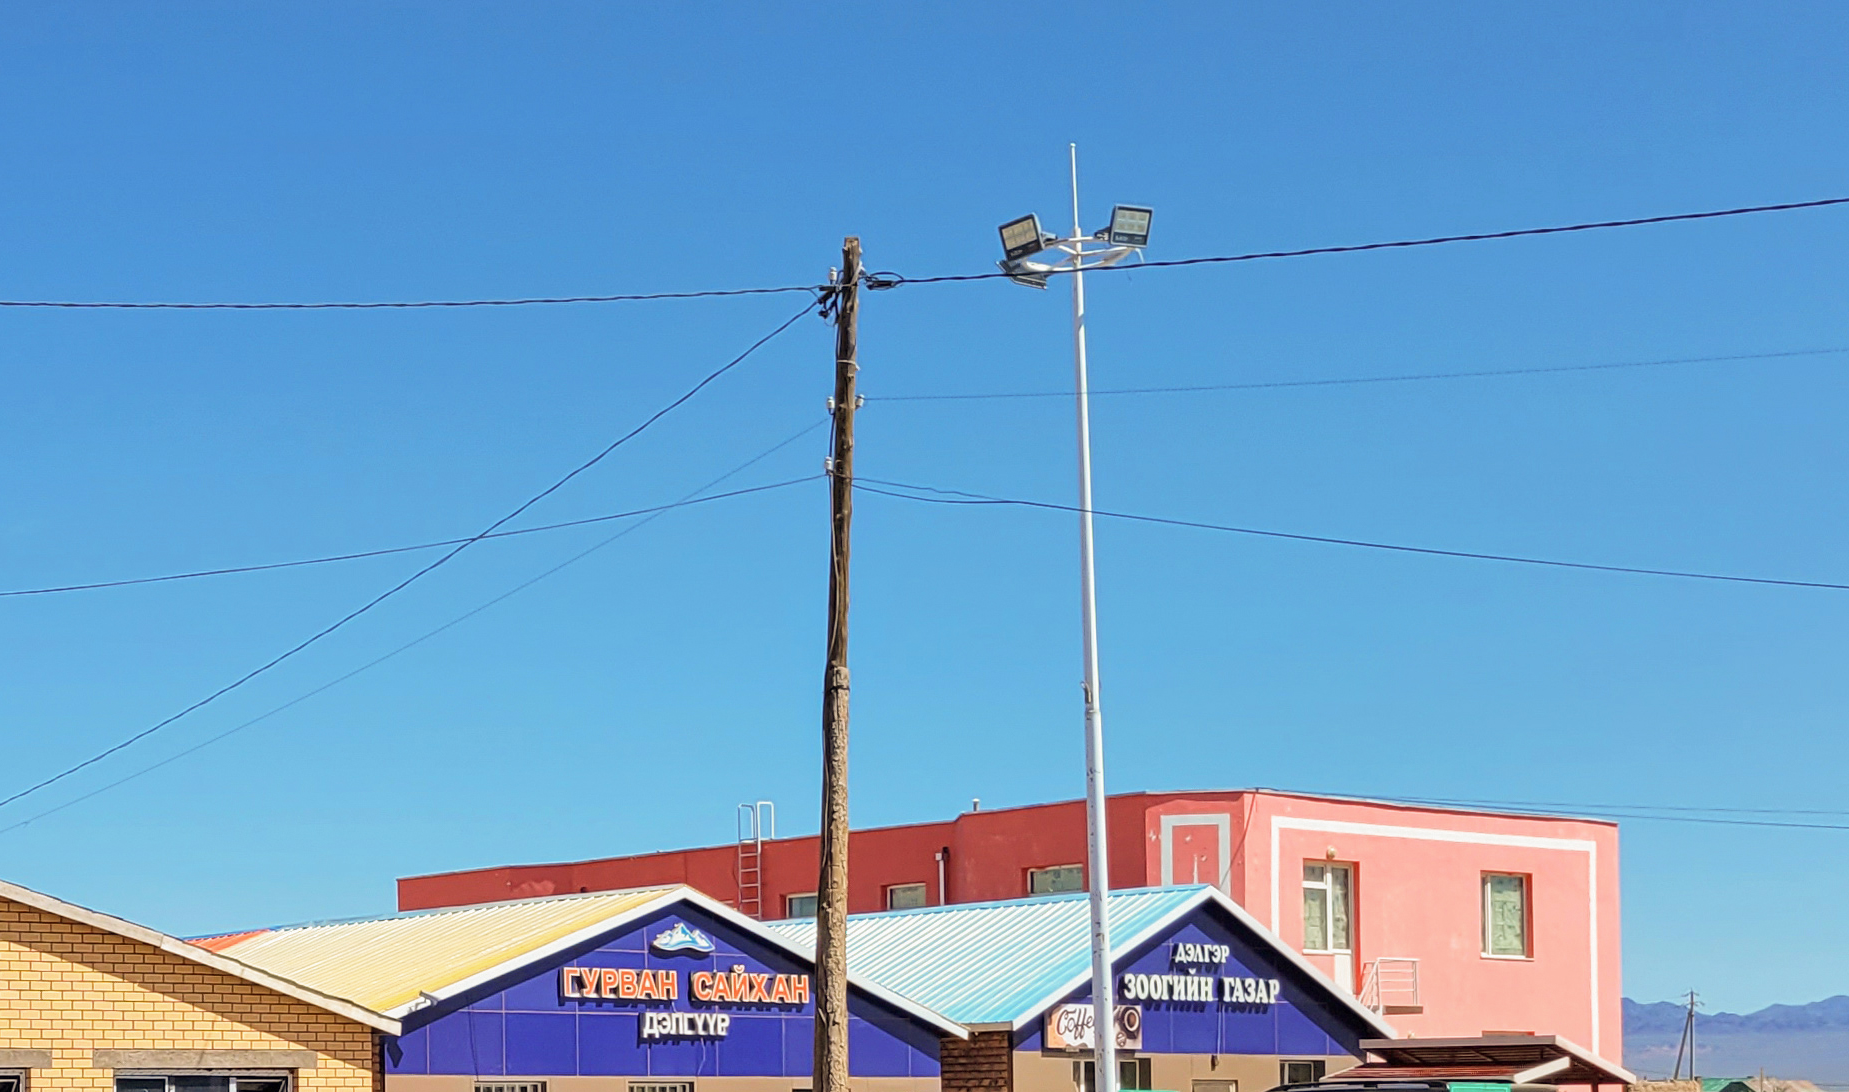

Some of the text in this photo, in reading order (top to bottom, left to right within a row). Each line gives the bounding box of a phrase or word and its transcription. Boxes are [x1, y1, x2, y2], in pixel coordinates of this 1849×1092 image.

[1174, 942, 1230, 964] ДЭЛГЭР
[563, 964, 810, 1004] ГУРВАН САЙХАН
[1123, 967, 1281, 1004] ЗООГИЙН ГАЗАР
[643, 1012, 730, 1038] ДЭЛГҮҮР
[1056, 1007, 1095, 1040] Coffe
